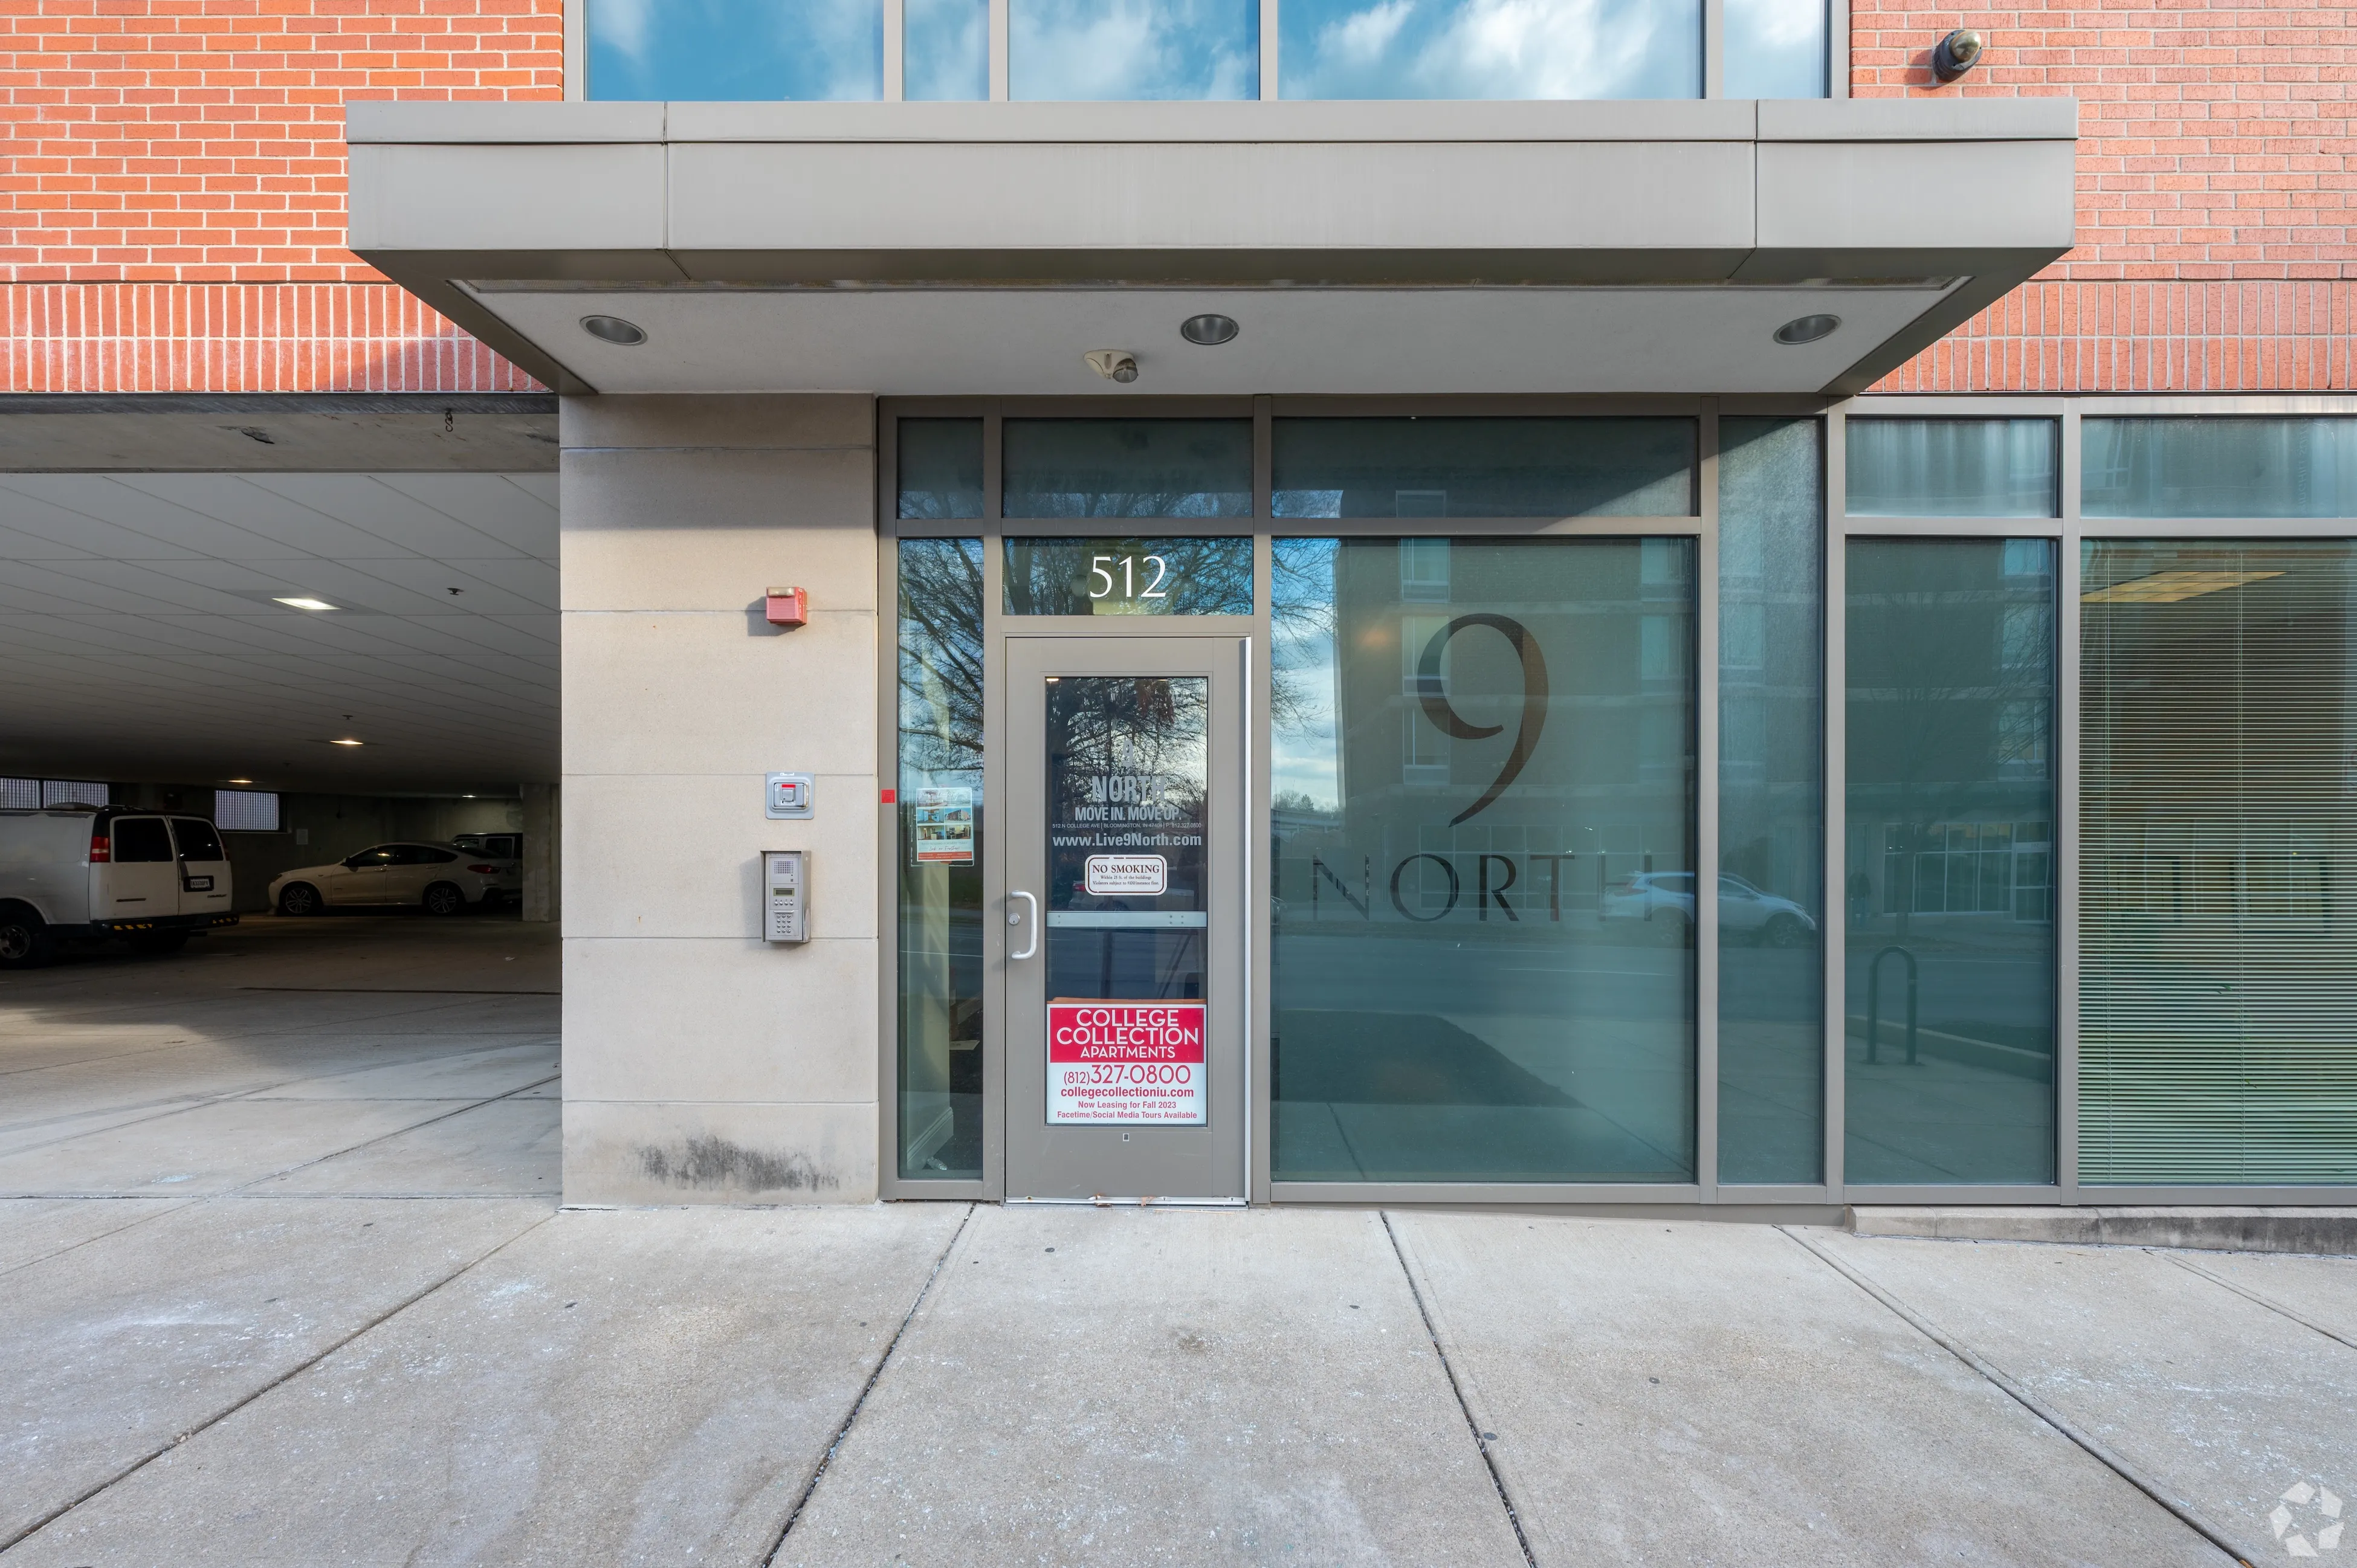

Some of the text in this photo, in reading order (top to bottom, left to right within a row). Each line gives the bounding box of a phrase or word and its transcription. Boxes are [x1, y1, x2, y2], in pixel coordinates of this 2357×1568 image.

[1090, 555, 1166, 598] 512
[1417, 613, 1549, 828] 9
[1122, 739, 1134, 768] 9
[1091, 775, 1166, 802] NORTH
[1075, 807, 1182, 821] MOVE IN. MOVE UP.
[1053, 832, 1201, 846] www.Live9North.com
[1092, 865, 1160, 874] NO SMOKING
[1313, 853, 1652, 922] NORTH
[1076, 1009, 1179, 1027] COLLEGE
[1056, 1027, 1198, 1045] COLLECTION
[1080, 1046, 1175, 1059] APARTMENTS
[1061, 1086, 1194, 1099] collegecollectioniu.com
[1098, 1101, 1127, 1110] Leasing
